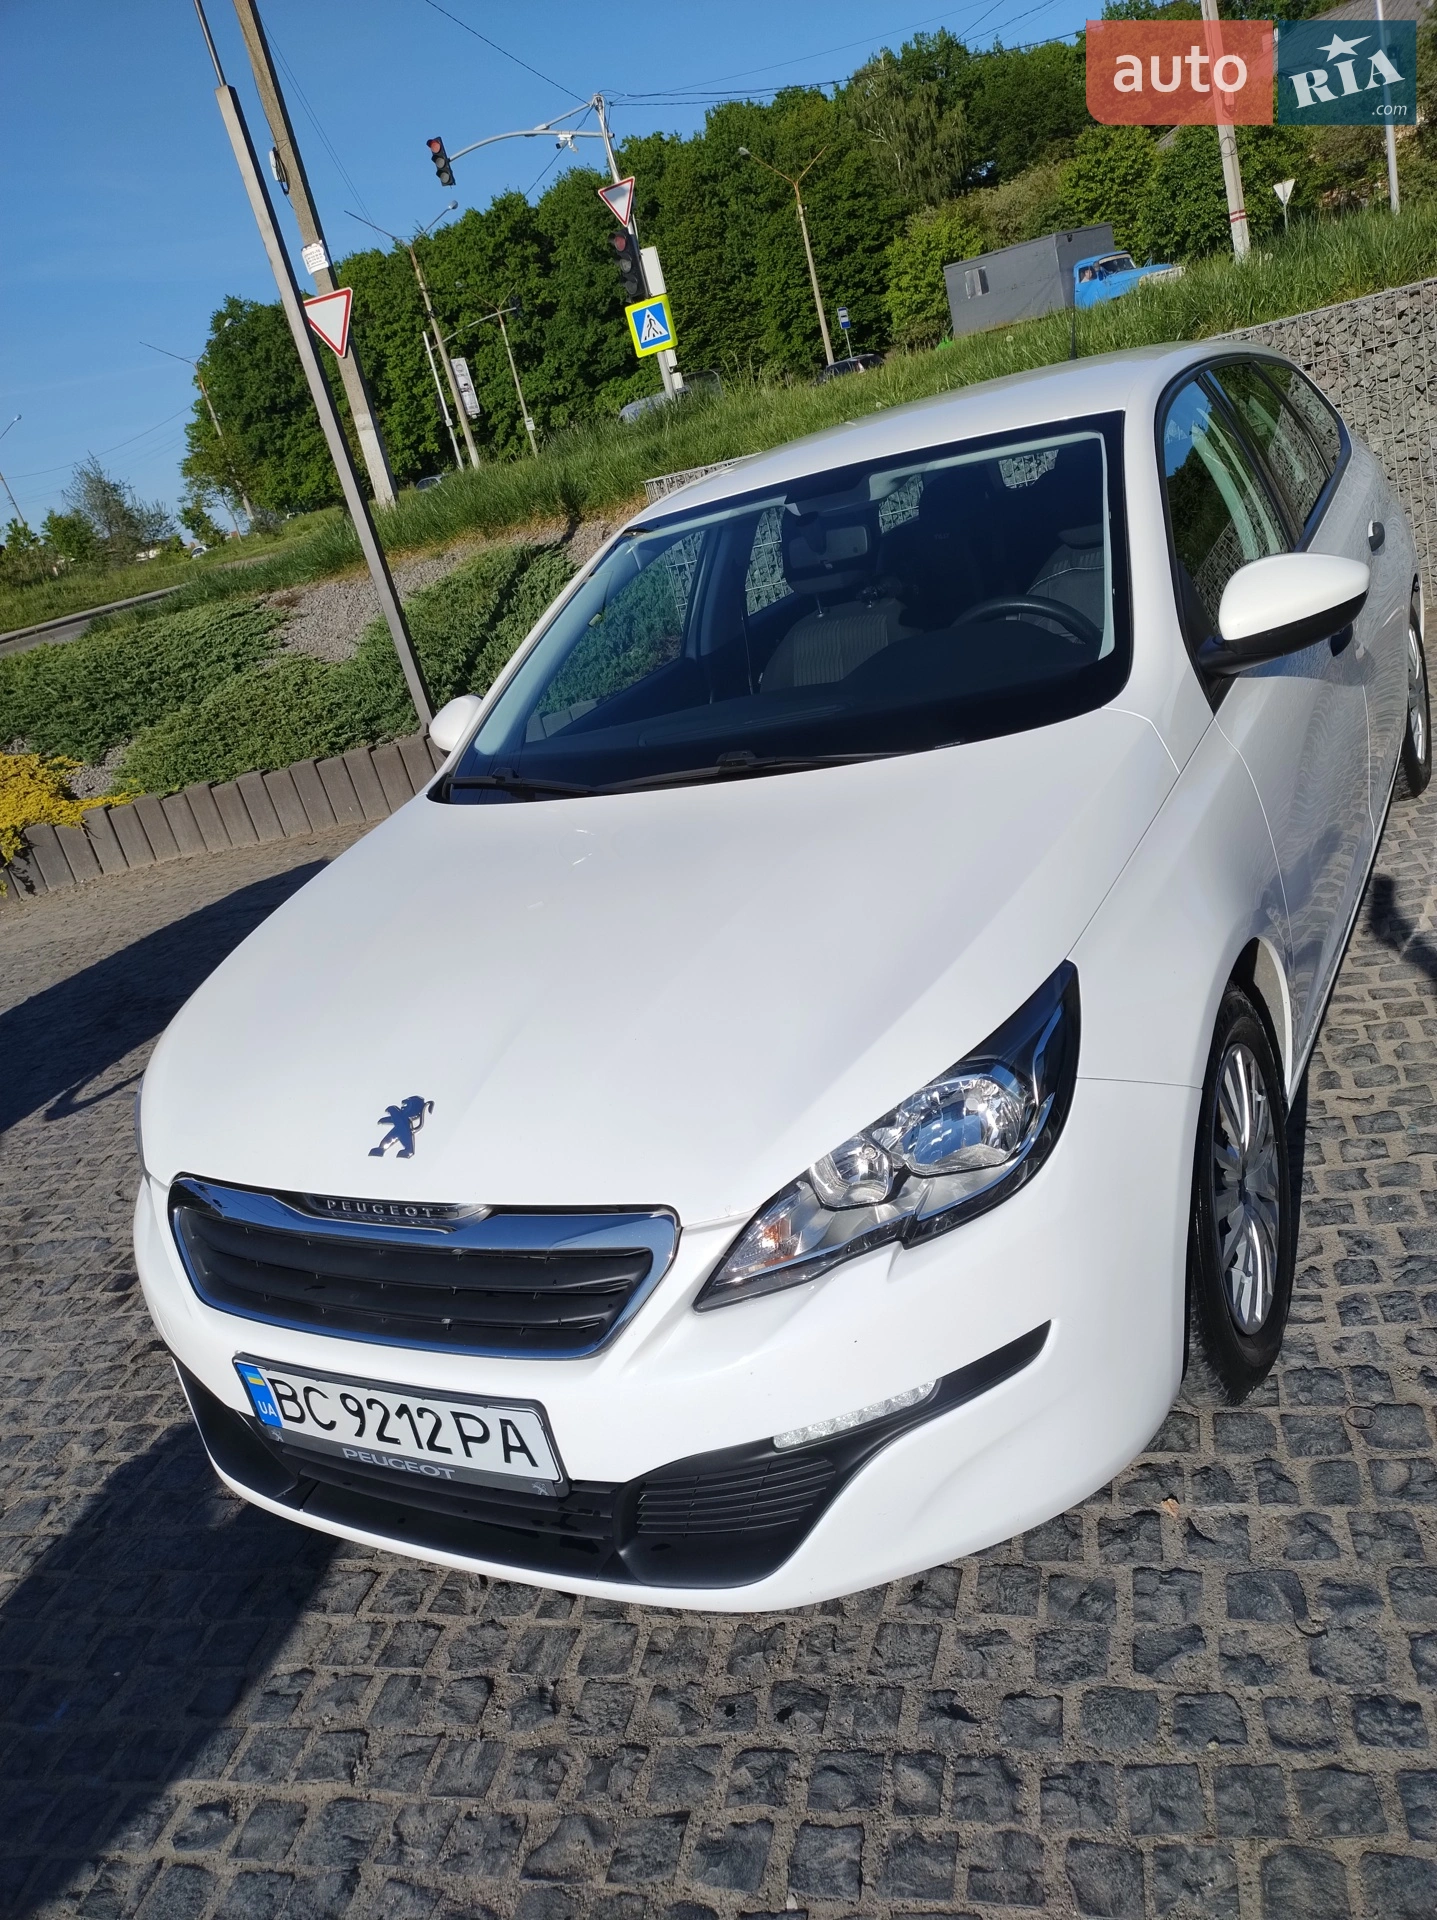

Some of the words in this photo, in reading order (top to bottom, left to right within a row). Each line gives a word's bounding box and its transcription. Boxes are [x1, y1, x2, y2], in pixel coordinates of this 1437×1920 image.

[327, 1199, 433, 1218] PEUGEOT
[257, 1400, 278, 1418] UA
[342, 1448, 455, 1480] PEUGEOT
